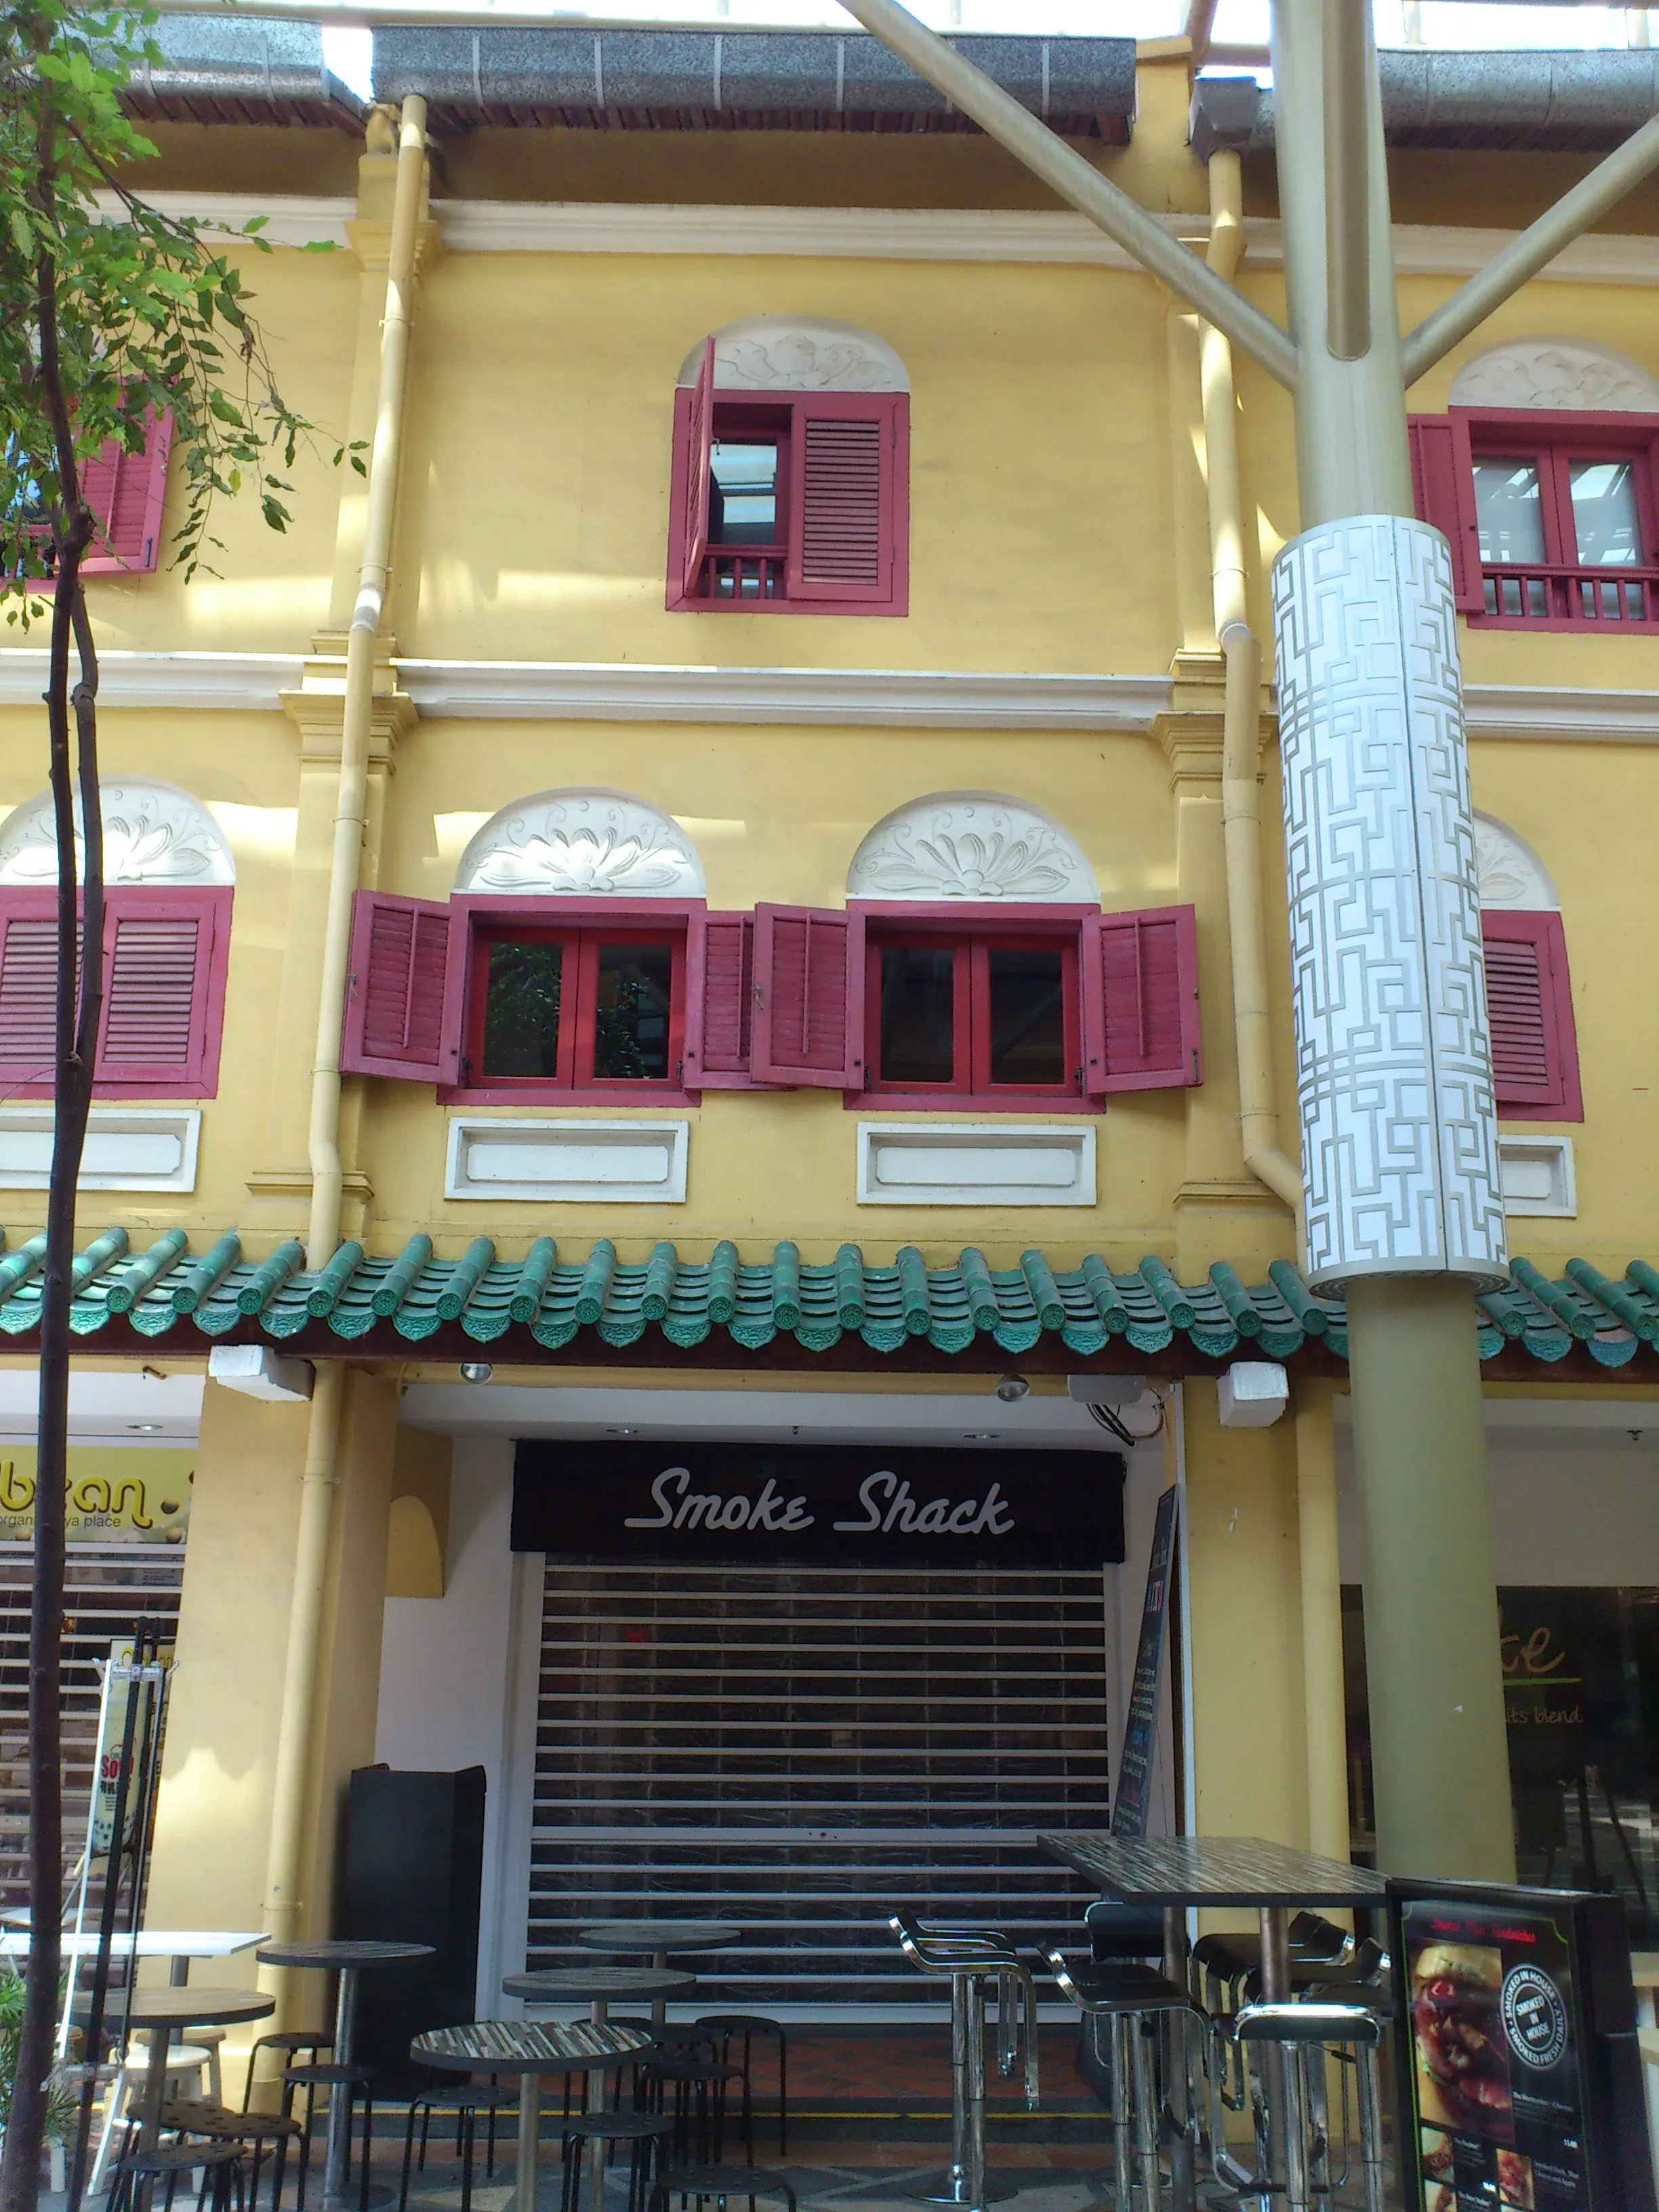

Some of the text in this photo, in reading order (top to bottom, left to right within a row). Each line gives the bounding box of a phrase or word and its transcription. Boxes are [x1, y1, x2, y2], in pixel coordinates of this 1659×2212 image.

[624, 1467, 1015, 1535] Smoke Shack
[84, 1515, 121, 1529] place
[1505, 1970, 1557, 2019] SMOKED IN HOUSE
[1515, 1994, 1545, 2016] SMOKED
[1529, 2011, 1540, 2025] IN
[1526, 2021, 1551, 2041] HOUSE
